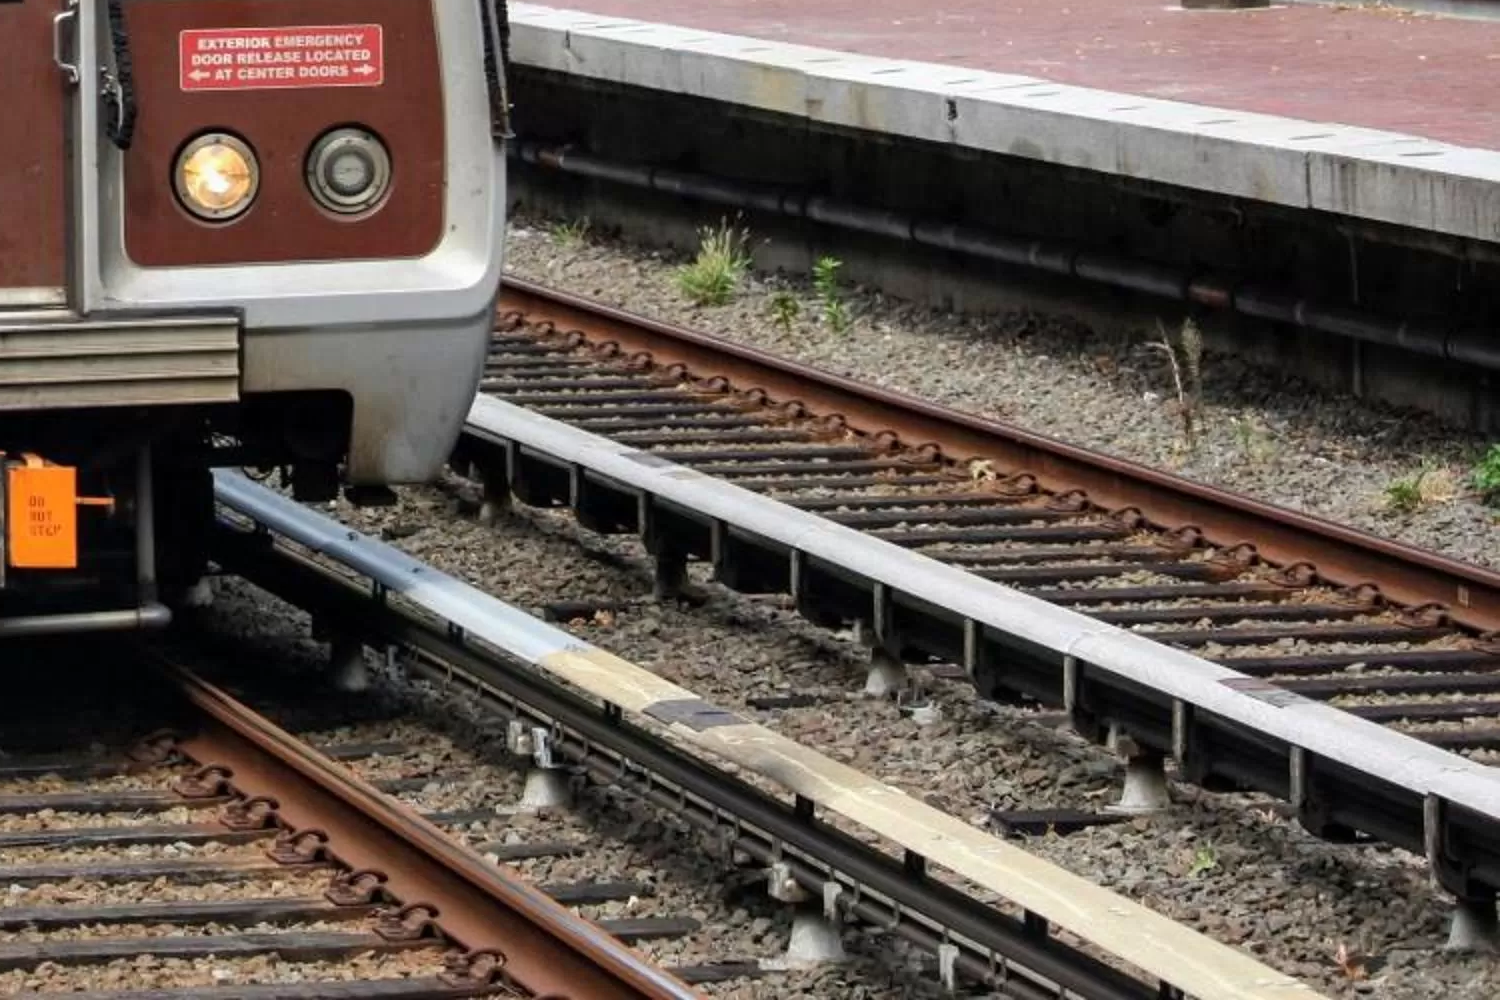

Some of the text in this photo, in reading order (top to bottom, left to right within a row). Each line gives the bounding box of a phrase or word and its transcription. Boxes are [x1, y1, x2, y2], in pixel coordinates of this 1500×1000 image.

[198, 33, 365, 51] EXTERIOR EMERGENCY
[191, 49, 371, 66] DOOR RELEASE LOCATED
[214, 64, 349, 81] AT CENTER DOORS
